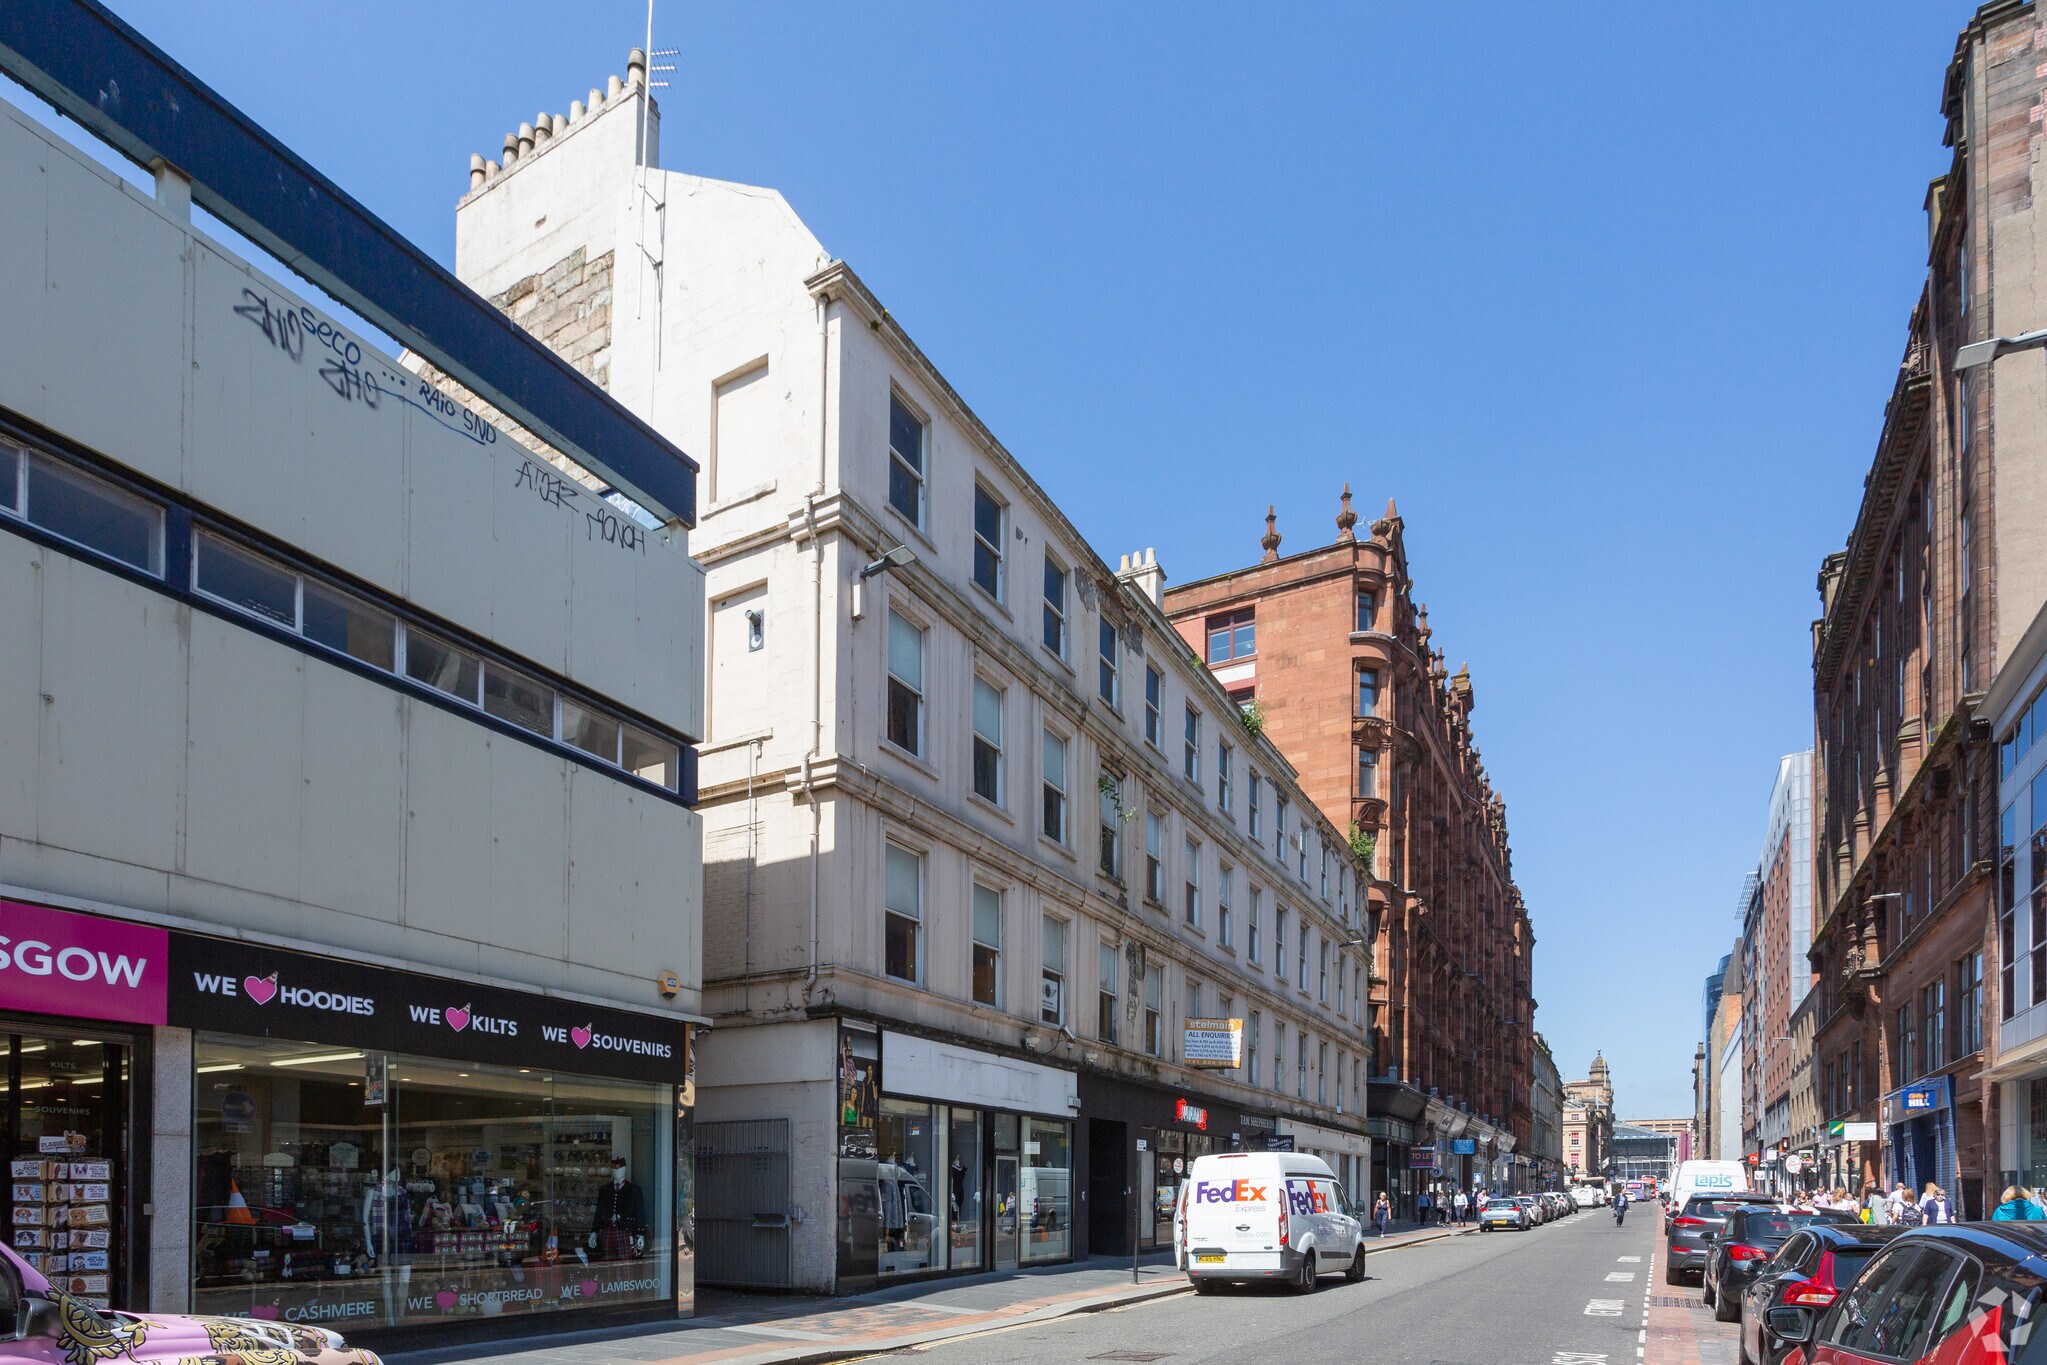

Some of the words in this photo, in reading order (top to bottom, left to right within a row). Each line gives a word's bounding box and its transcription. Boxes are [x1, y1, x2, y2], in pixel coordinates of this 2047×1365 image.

[194, 972, 237, 996] WE
[280, 986, 374, 1016] HOODIES
[409, 1005, 440, 1026] WE
[472, 1015, 518, 1037] KILTS
[1190, 1020, 1234, 1029] stelmain
[542, 1025, 567, 1044] WE
[592, 1034, 672, 1058] SOUVENIRS
[51, 1061, 76, 1069] KILTS
[35, 1106, 90, 1115] SOUVENIRS
[1240, 1115, 1250, 1125] TAM
[1250, 1116, 1275, 1129] SHEPHERDS
[1422, 1152, 1434, 1160] LET
[1694, 1173, 1733, 1188] Lapis
[1197, 1179, 1268, 1204] FedEx
[1286, 1180, 1330, 1216] FedEx
[1235, 1204, 1266, 1213] Express
[408, 1296, 433, 1310] WE
[459, 1288, 543, 1306] SHORTBREAD
[561, 1285, 581, 1299] WE
[285, 1301, 375, 1322] CASHMERE
